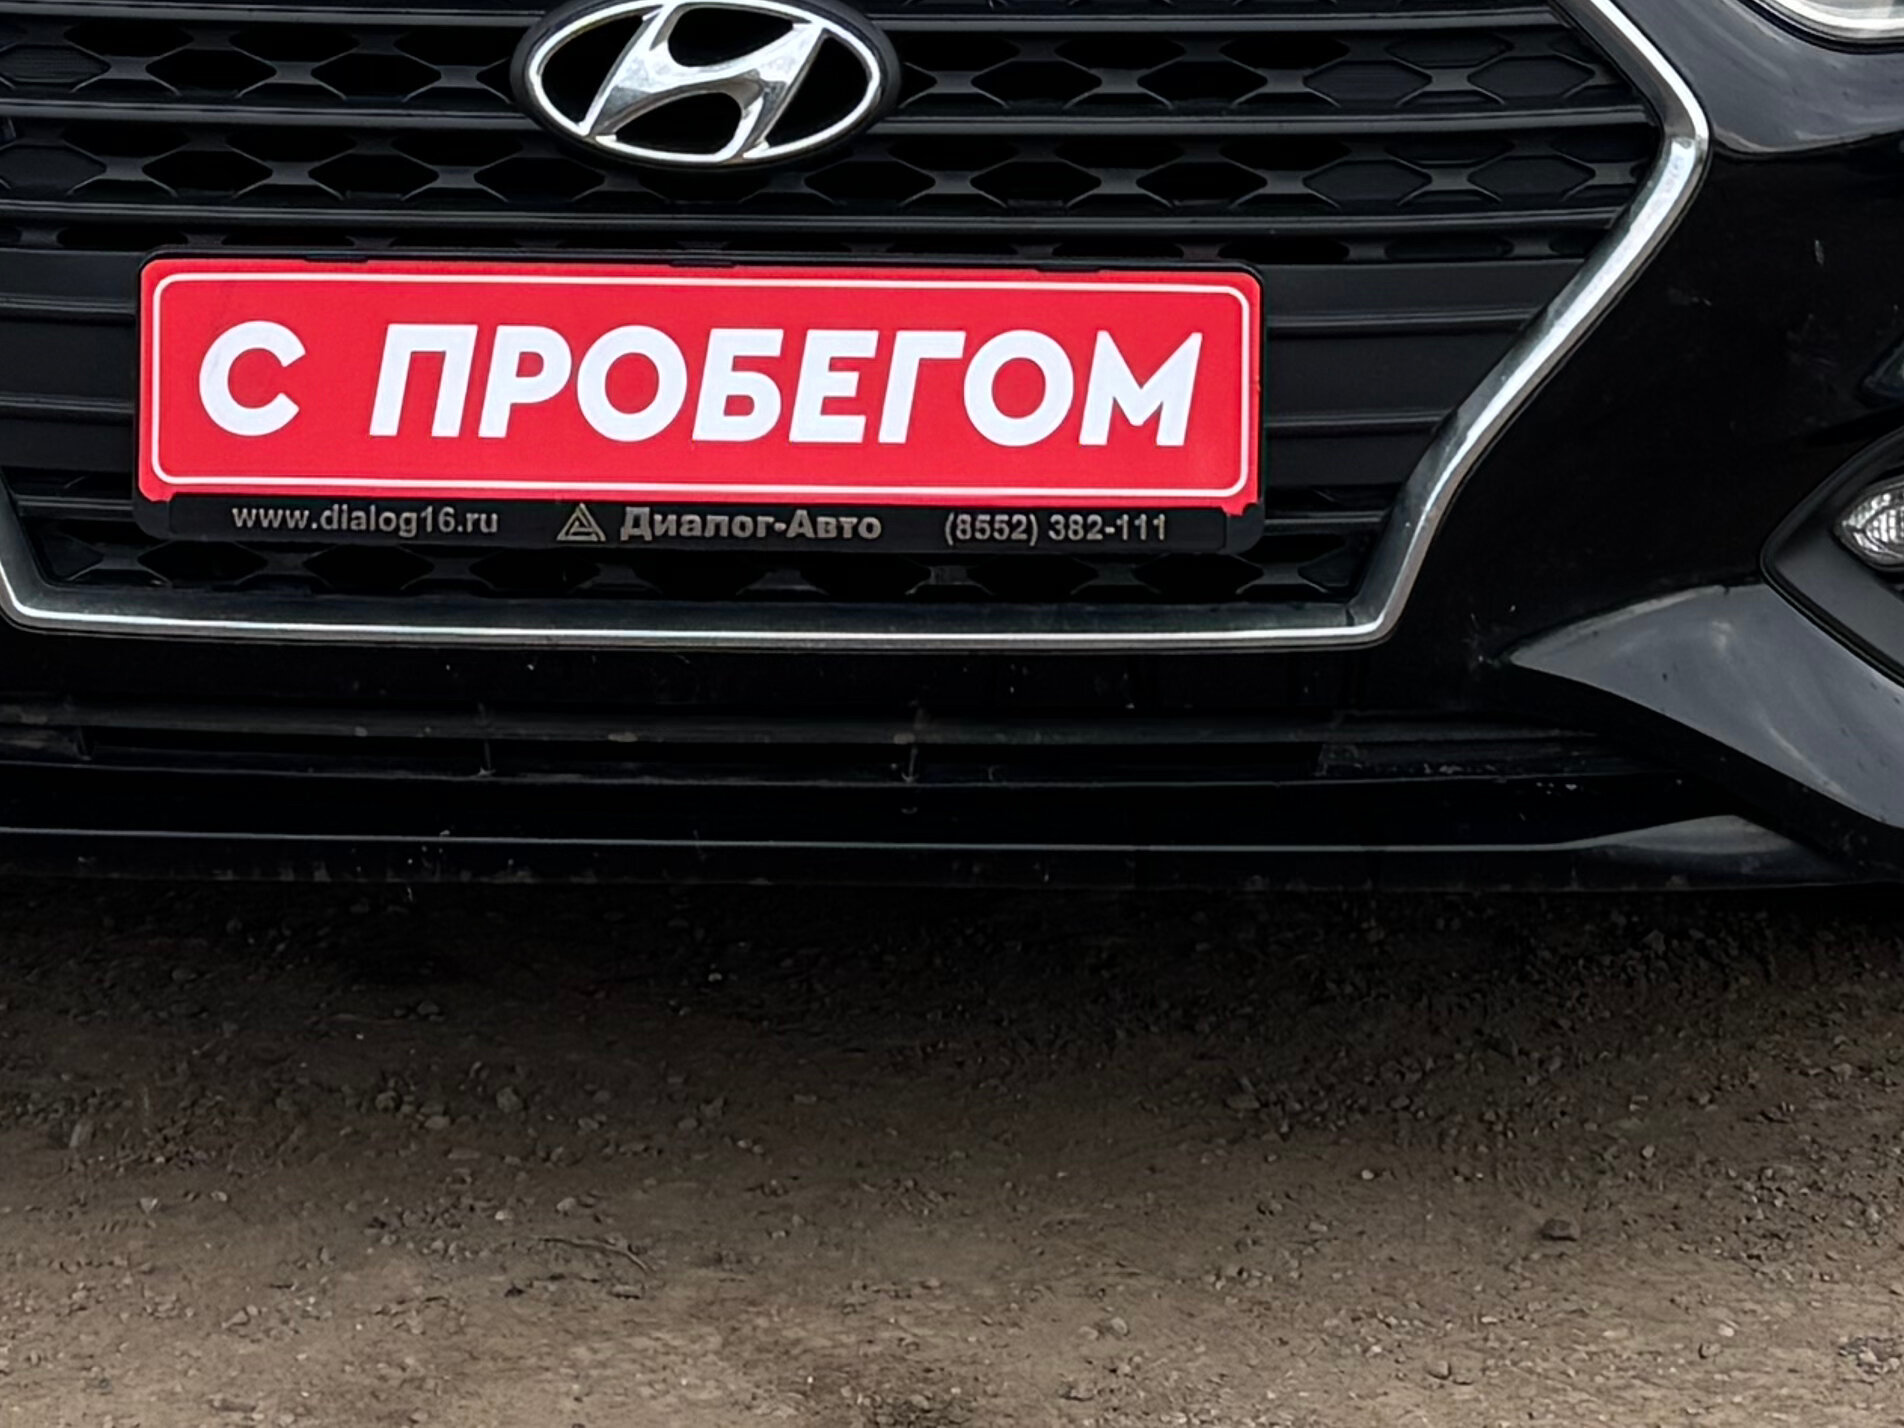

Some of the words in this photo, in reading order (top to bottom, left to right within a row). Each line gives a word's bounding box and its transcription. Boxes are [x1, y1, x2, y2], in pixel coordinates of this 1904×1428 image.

[198, 320, 307, 438] С
[368, 322, 1204, 448] ПРОБЕГОМ
[231, 503, 499, 538] www.dialog16.ru
[944, 512, 1039, 547] (8552)
[1047, 513, 1167, 541] 382-111
